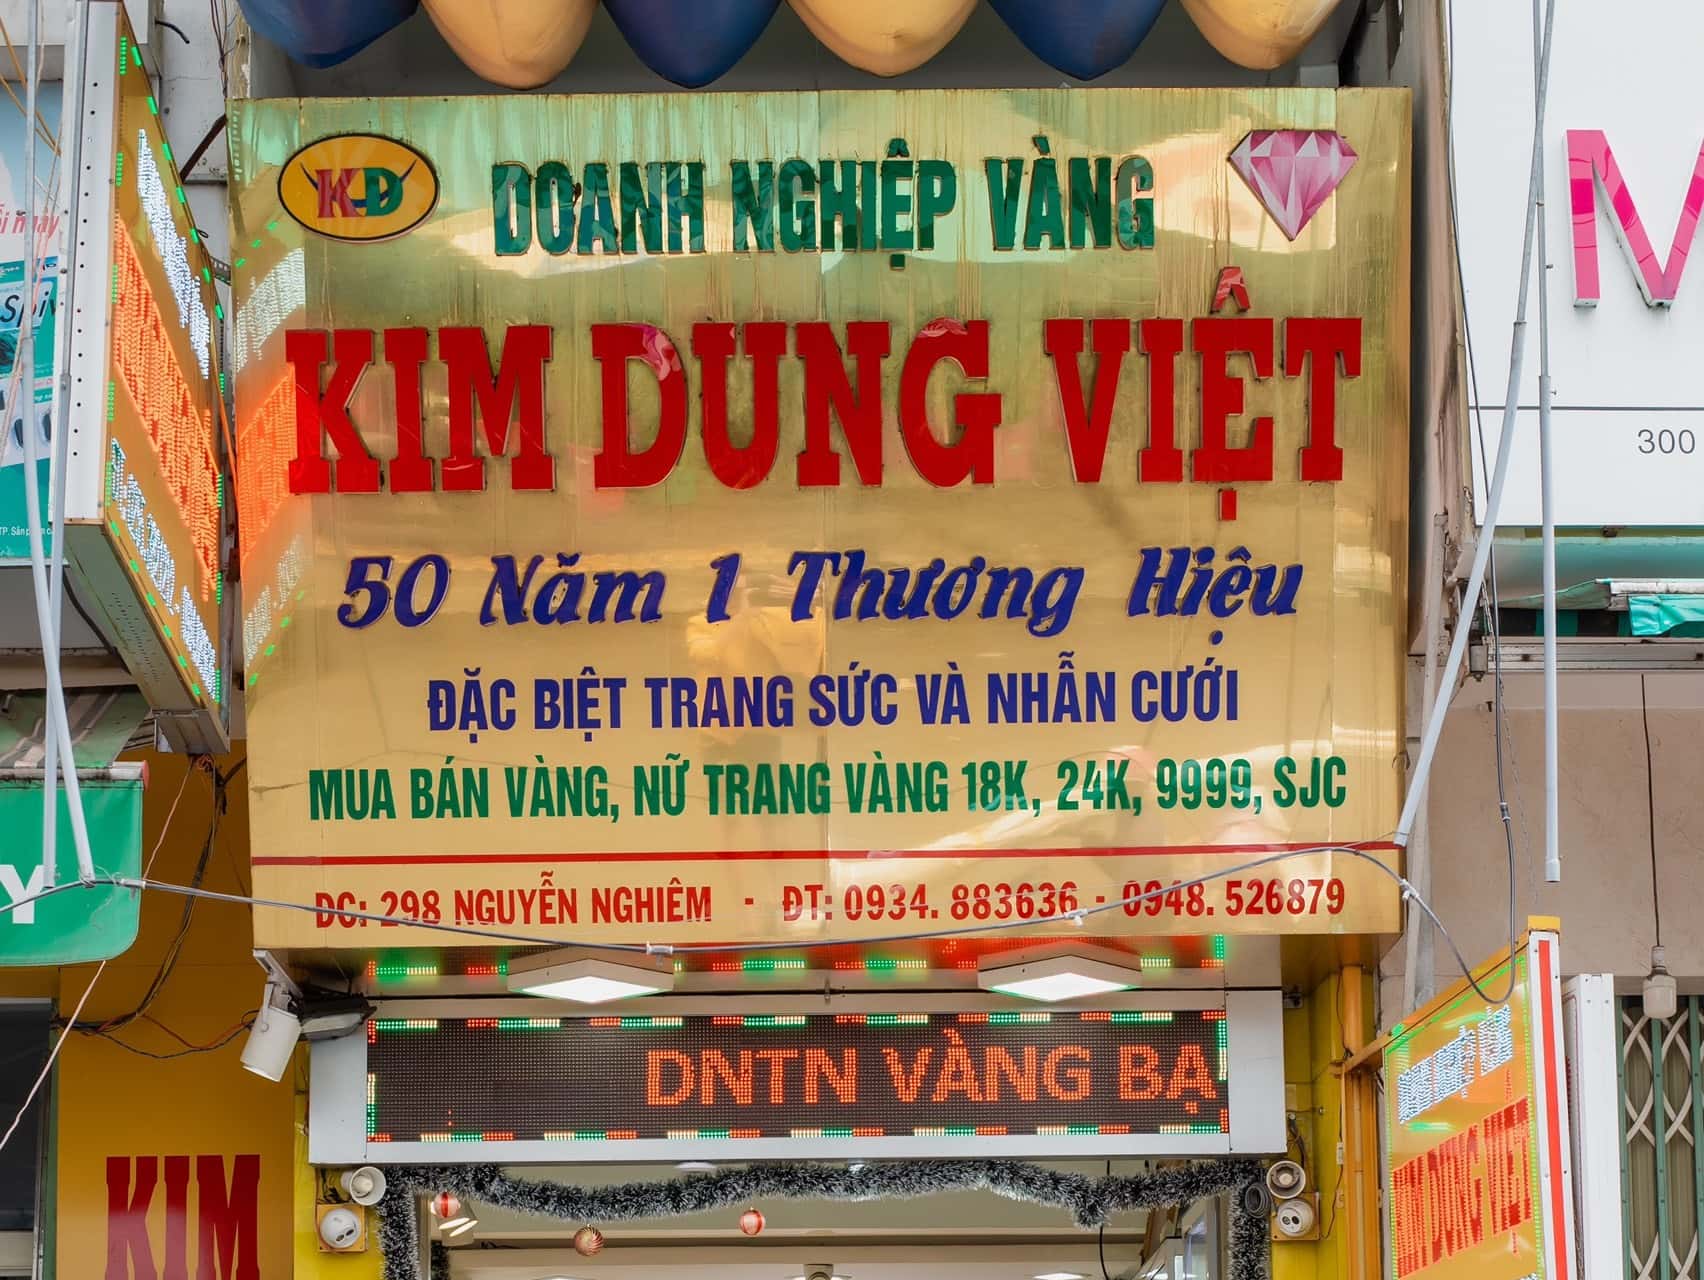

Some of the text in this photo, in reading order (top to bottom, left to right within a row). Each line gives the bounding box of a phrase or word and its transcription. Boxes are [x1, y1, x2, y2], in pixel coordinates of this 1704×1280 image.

[490, 135, 1155, 269] DOANH NGHIỆP VÀNG
[285, 325, 555, 496] KIM
[592, 320, 1002, 490] DUNG
[1045, 266, 1362, 521] VIỆT
[1637, 428, 1696, 455] 300
[338, 546, 1303, 645] 50 Năm 1 Thương Hiệu
[427, 651, 1238, 744] ĐẶC BIỆT TRANG SỨC VÀ NHẪN CƯỚI
[309, 751, 1347, 823] MUA BÁN VÀNG, NỮ TRANG VÀNG 18K, 24K, 9999, SJC
[380, 889, 442, 927] 298
[454, 870, 578, 925] NGUYỄN
[591, 877, 712, 924] NGHIÊM
[782, 884, 833, 920] ĐT:
[844, 884, 938, 921] 0934.
[950, 881, 1078, 920] 883636
[1122, 880, 1214, 917] 0948.
[1225, 878, 1345, 917] 526879
[646, 1028, 1218, 1115] DNTN VÀNG BẠ
